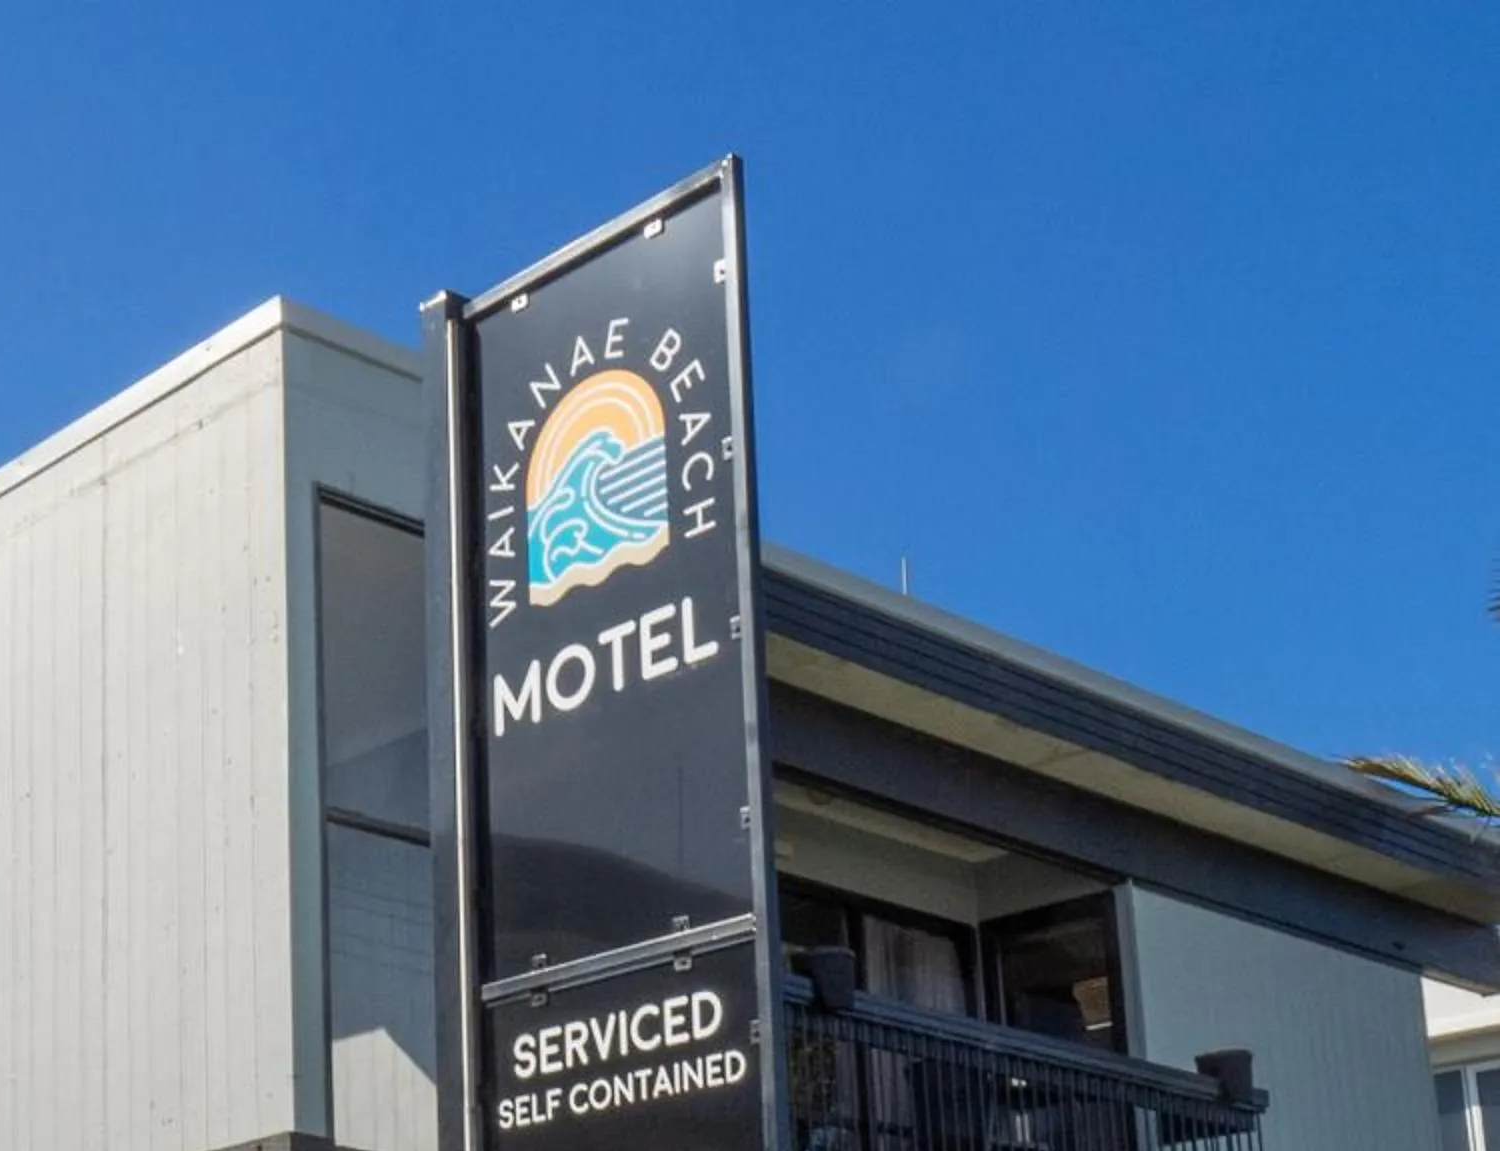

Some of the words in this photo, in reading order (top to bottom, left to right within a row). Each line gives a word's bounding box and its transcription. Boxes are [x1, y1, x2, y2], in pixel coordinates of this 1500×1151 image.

[488, 318, 629, 628] WAIKANAE
[650, 329, 717, 538] BEACH
[494, 597, 719, 736] MOTEL
[499, 1088, 563, 1129] SELF
[569, 1049, 747, 1115] CONTAINED
[513, 990, 723, 1079] SERVICED
